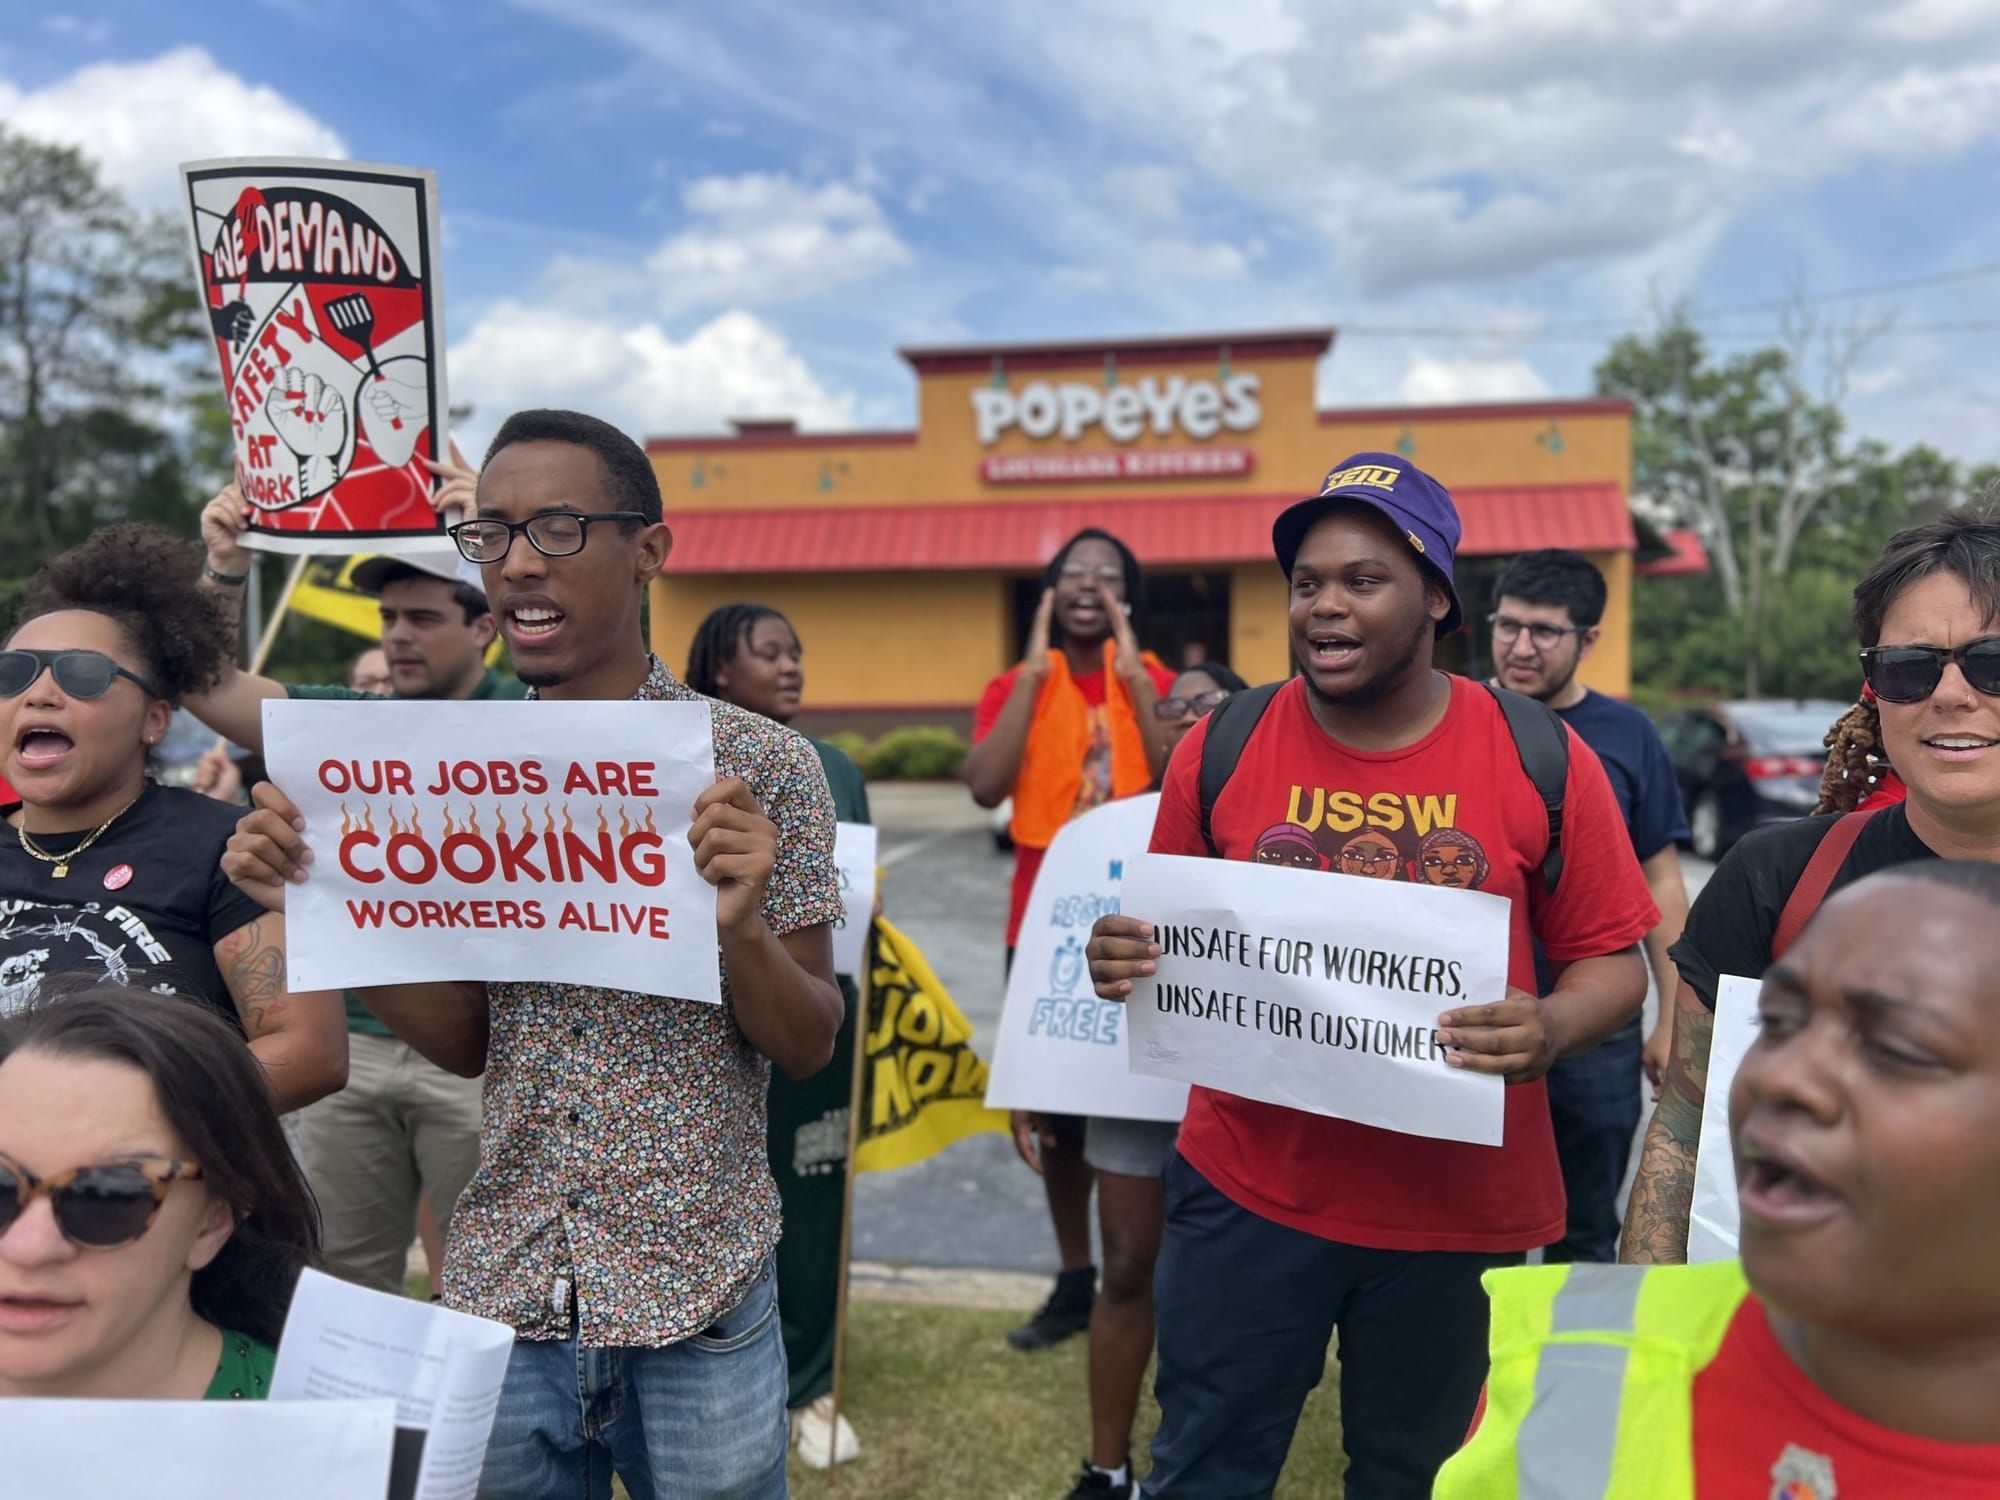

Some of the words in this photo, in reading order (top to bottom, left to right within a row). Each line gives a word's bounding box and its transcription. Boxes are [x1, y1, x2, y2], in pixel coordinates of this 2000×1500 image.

[213, 219, 249, 279] WE
[255, 200, 398, 284] DEMAND
[231, 298, 313, 441] SAFETY
[248, 434, 278, 470] AT
[240, 461, 295, 506] WORK
[317, 758, 415, 796] OUR
[427, 760, 549, 796] JOBS
[562, 760, 660, 798] ARE
[1285, 784, 1458, 837] USSW
[338, 829, 667, 888] COOKING
[103, 905, 173, 965] FIRE
[346, 899, 546, 930] WORKERS
[558, 901, 671, 941] ALIVE
[1153, 924, 1251, 968] UNSAFE
[1258, 936, 1314, 978] FOR
[1322, 943, 1467, 1001] WORKERS,
[1027, 997, 1122, 1046] FREE
[1156, 983, 1248, 1029] UNSAFE
[1255, 999, 1303, 1041] FOR
[1310, 1011, 1460, 1062] CUSTOMER
